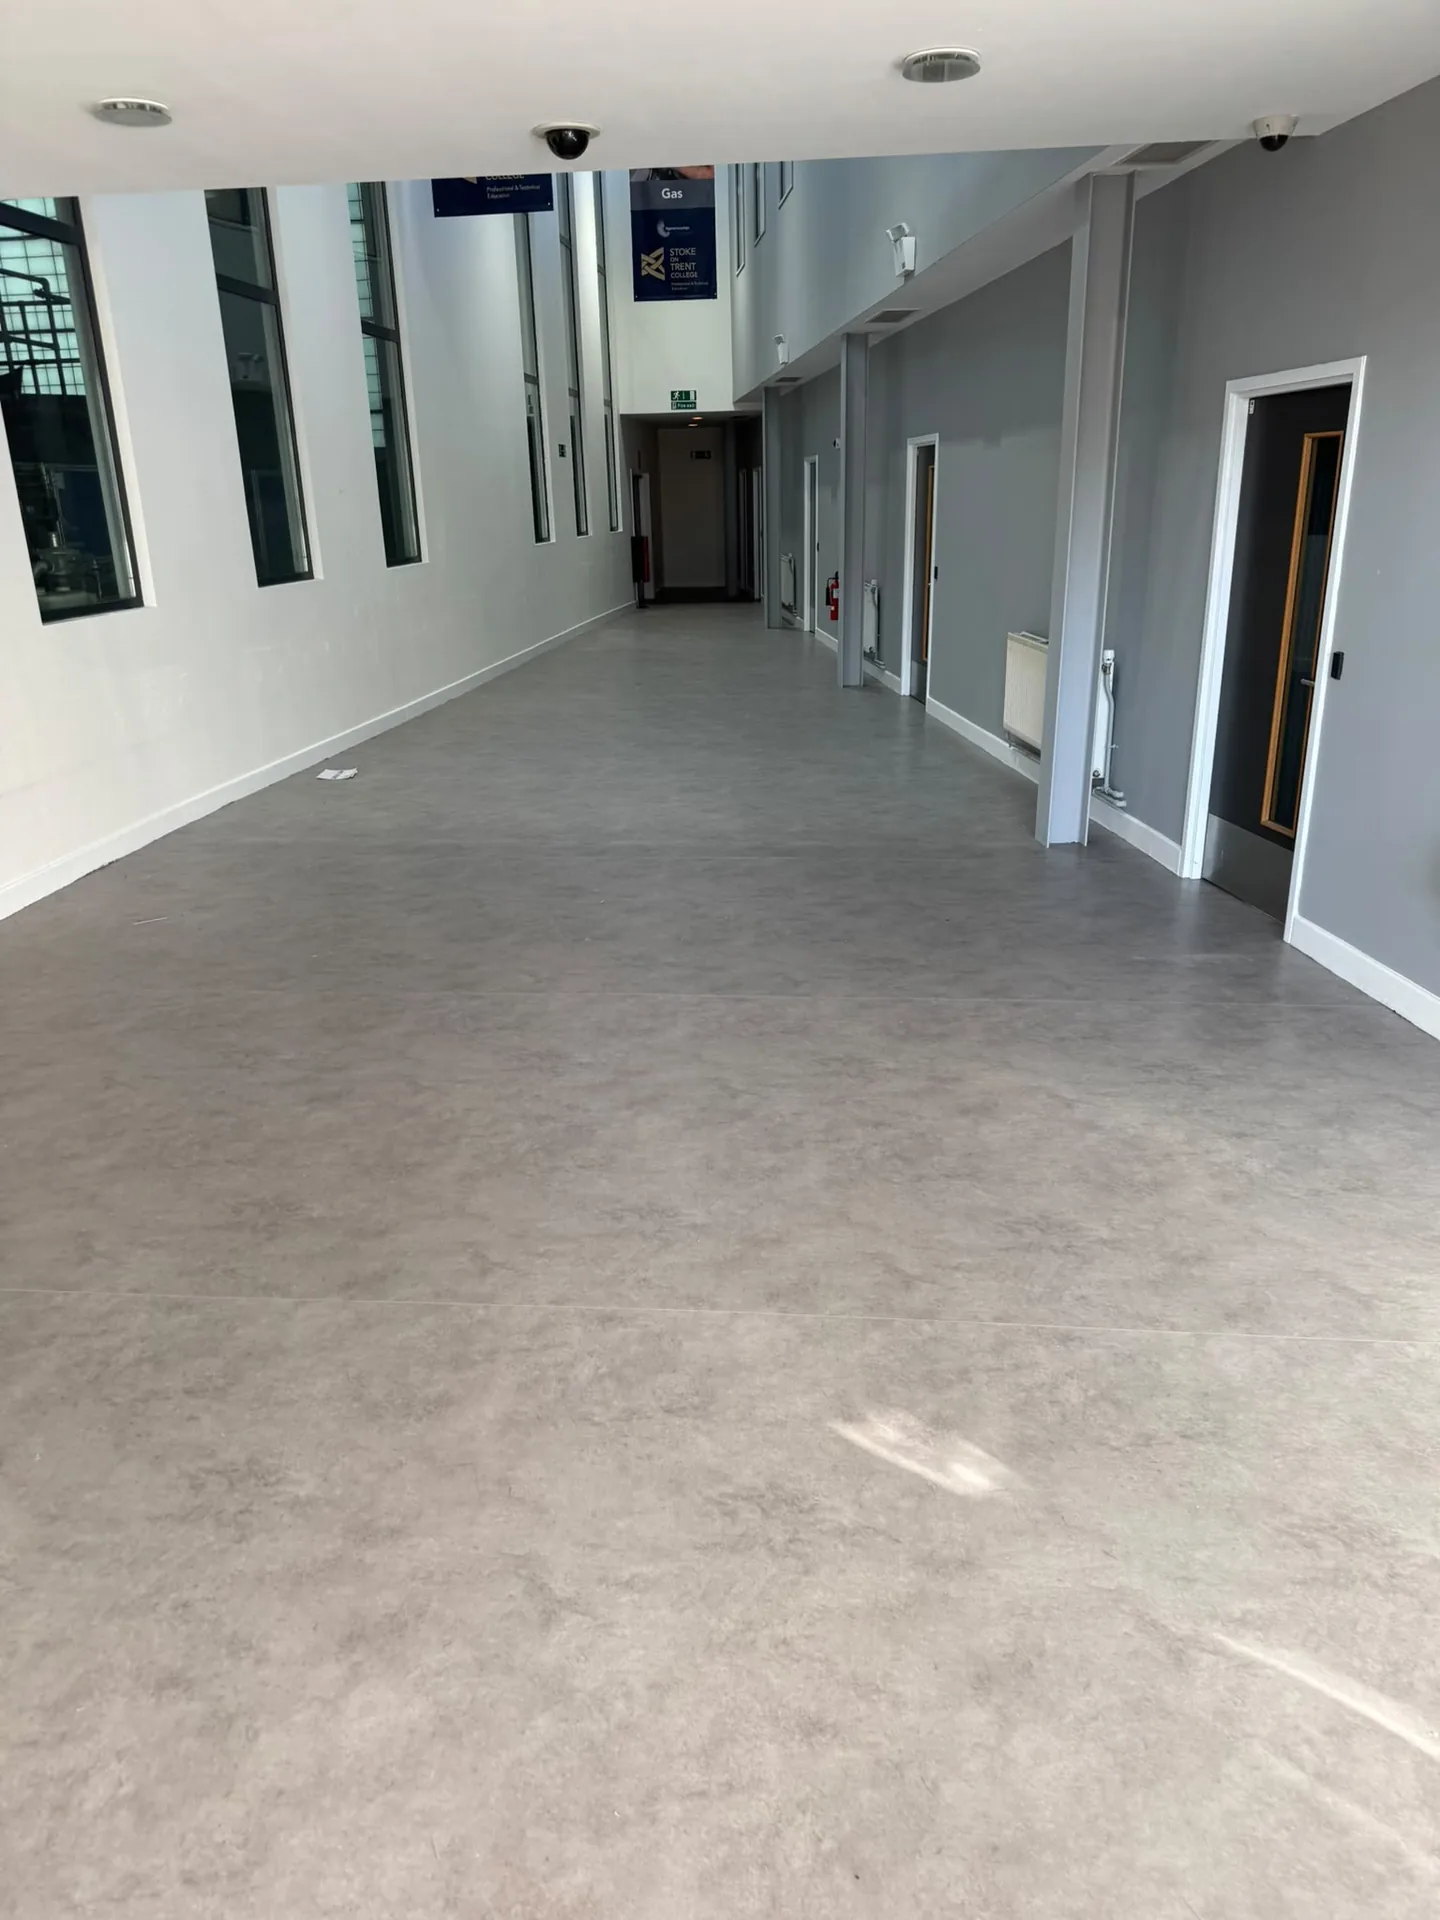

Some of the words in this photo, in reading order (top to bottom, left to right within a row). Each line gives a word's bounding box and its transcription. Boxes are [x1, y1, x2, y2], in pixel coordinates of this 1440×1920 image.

[661, 187, 683, 199] Gas
[670, 247, 696, 256] STOKE
[670, 262, 697, 271] TRENT
[670, 271, 698, 279] COLLEGE
